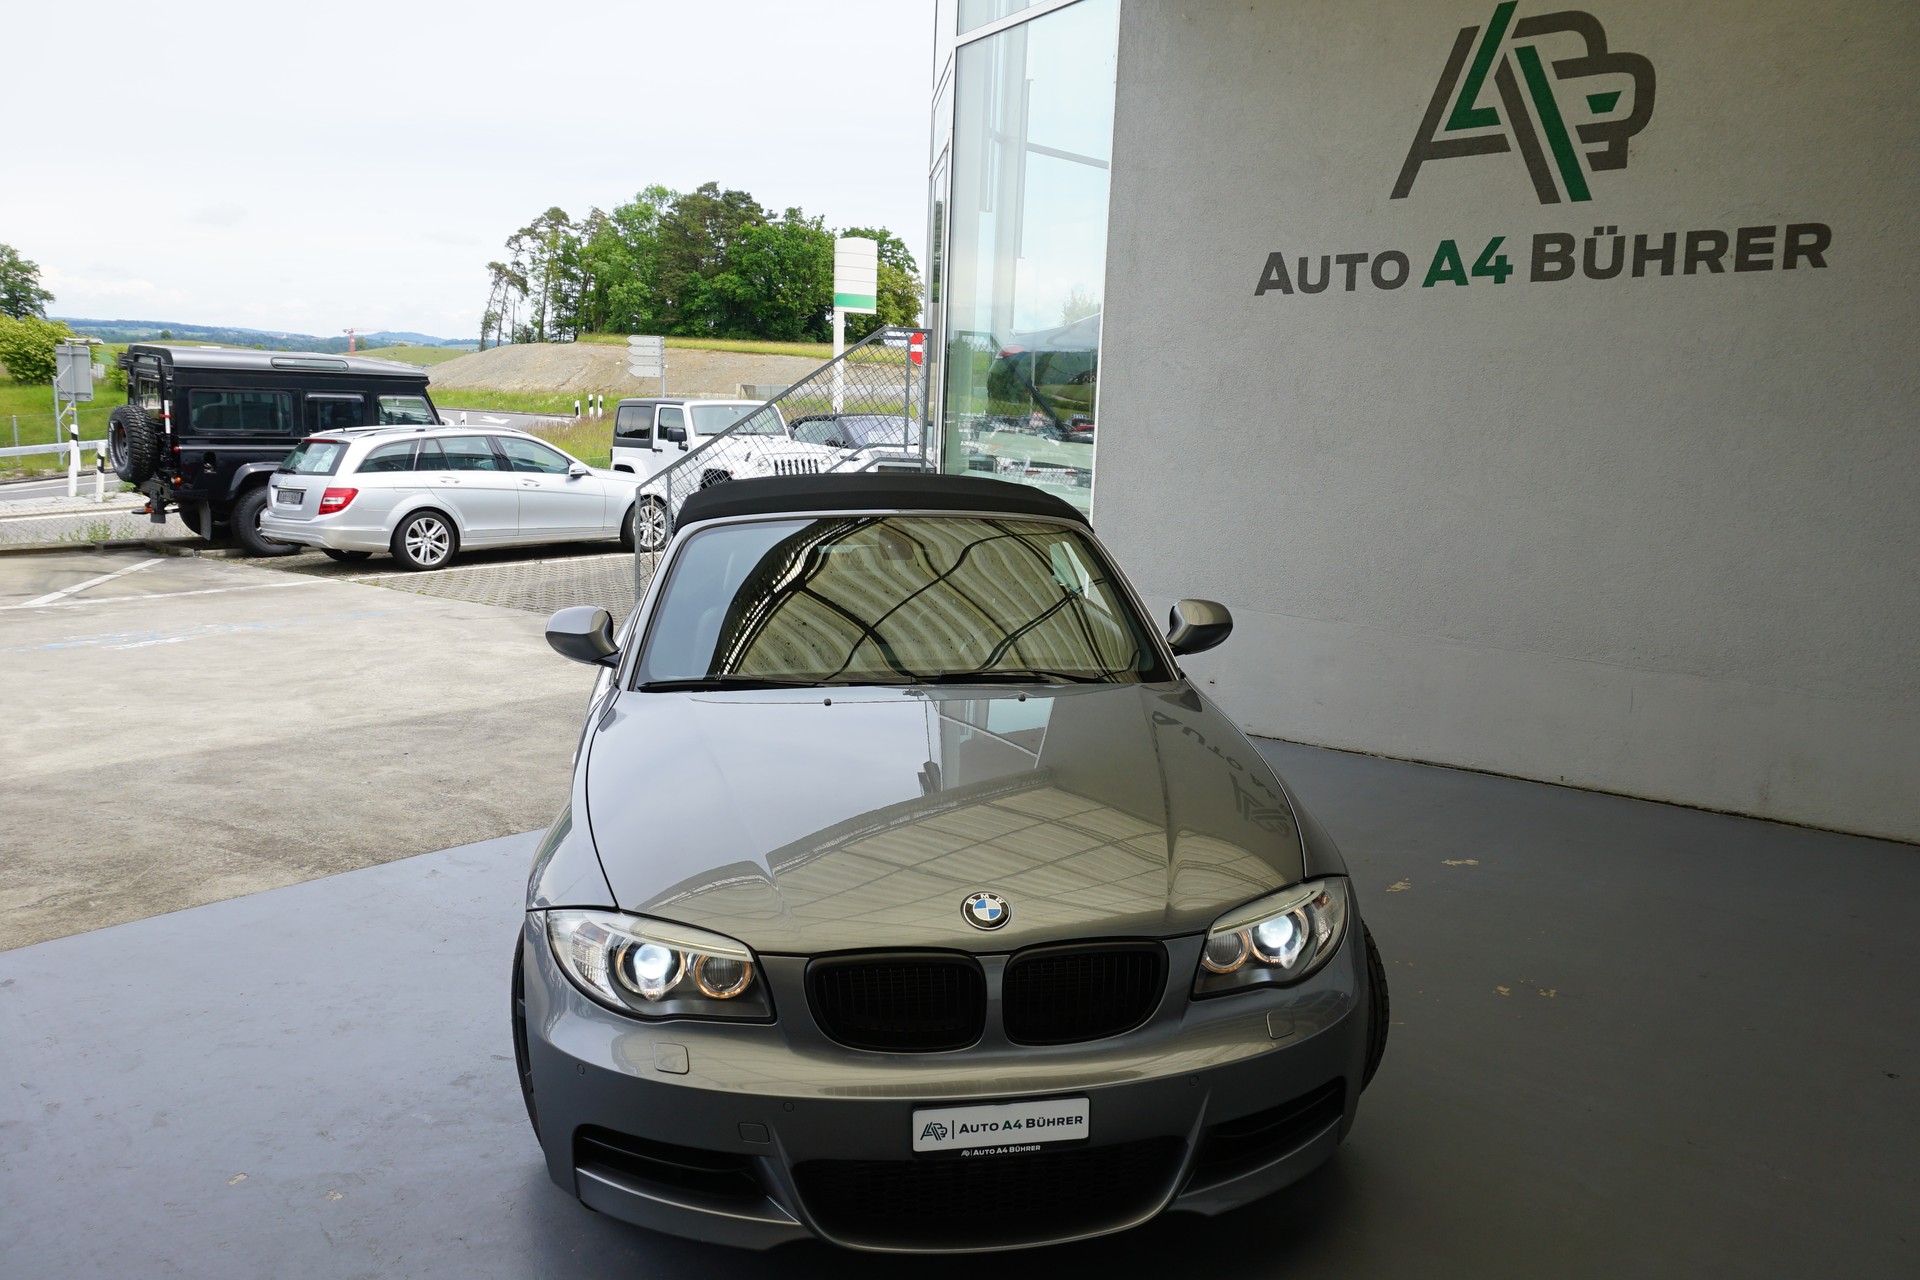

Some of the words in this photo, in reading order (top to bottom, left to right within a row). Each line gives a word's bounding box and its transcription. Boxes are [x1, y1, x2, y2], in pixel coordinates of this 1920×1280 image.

[1254, 250, 1410, 296] AUTO
[1422, 236, 1513, 288] A4
[1529, 222, 1833, 283] BÜHRER
[959, 1122, 999, 1135] AUTO
[1002, 1119, 1022, 1131] A4
[1025, 1115, 1083, 1129] BÜHRER
[973, 1148, 995, 1156] AUTO
